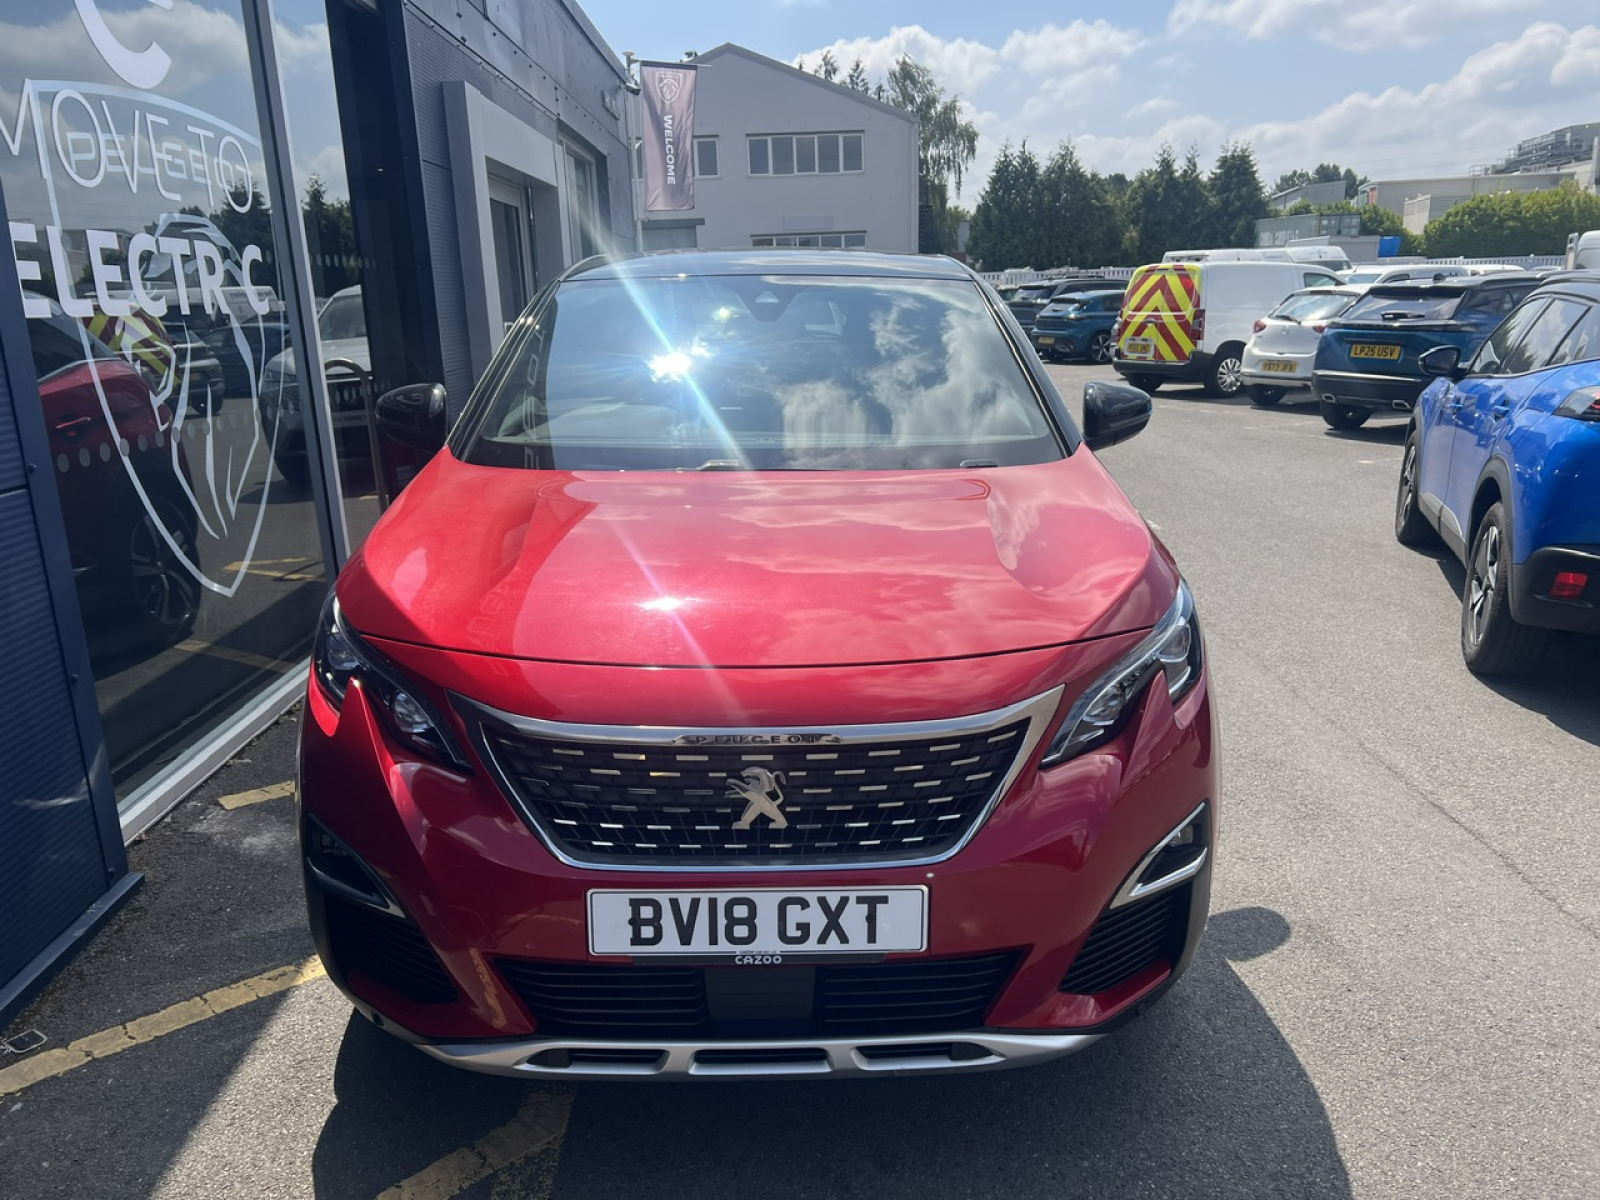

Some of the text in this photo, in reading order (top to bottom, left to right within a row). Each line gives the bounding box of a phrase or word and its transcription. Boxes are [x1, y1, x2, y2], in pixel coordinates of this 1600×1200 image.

[0, 78, 253, 214] MOVE TO
[663, 114, 676, 185] WELCOME
[1353, 345, 1396, 358] LP25 USV
[694, 735, 821, 745] PEUGEOT
[628, 895, 890, 946] BV18 GXT
[735, 954, 782, 965] CAZOO
